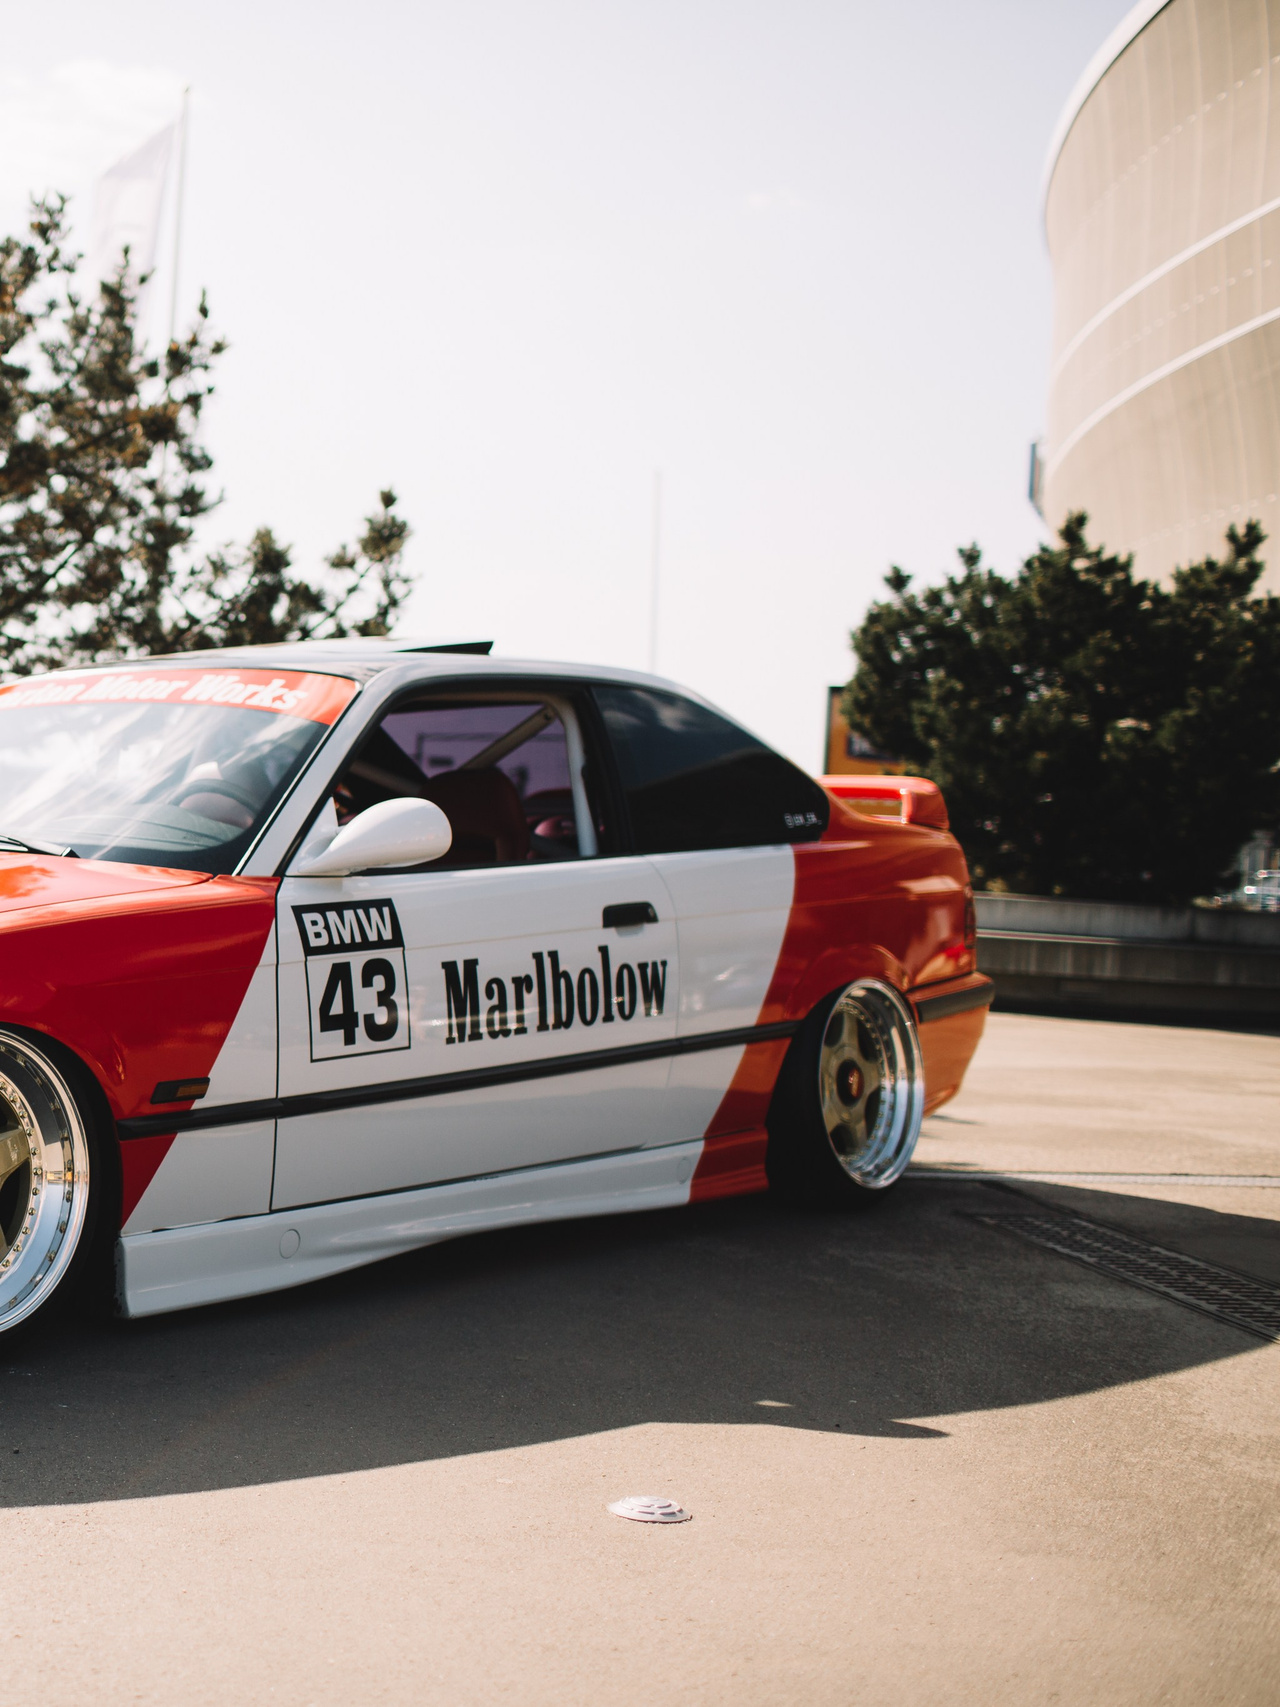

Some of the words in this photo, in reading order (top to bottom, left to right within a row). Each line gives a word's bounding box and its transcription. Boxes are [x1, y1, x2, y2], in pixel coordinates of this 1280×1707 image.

[76, 675, 190, 702] Motor
[181, 674, 308, 709] Works
[301, 906, 393, 948] BMW
[318, 957, 400, 1047] 43
[441, 944, 668, 1045] Marlbolow
